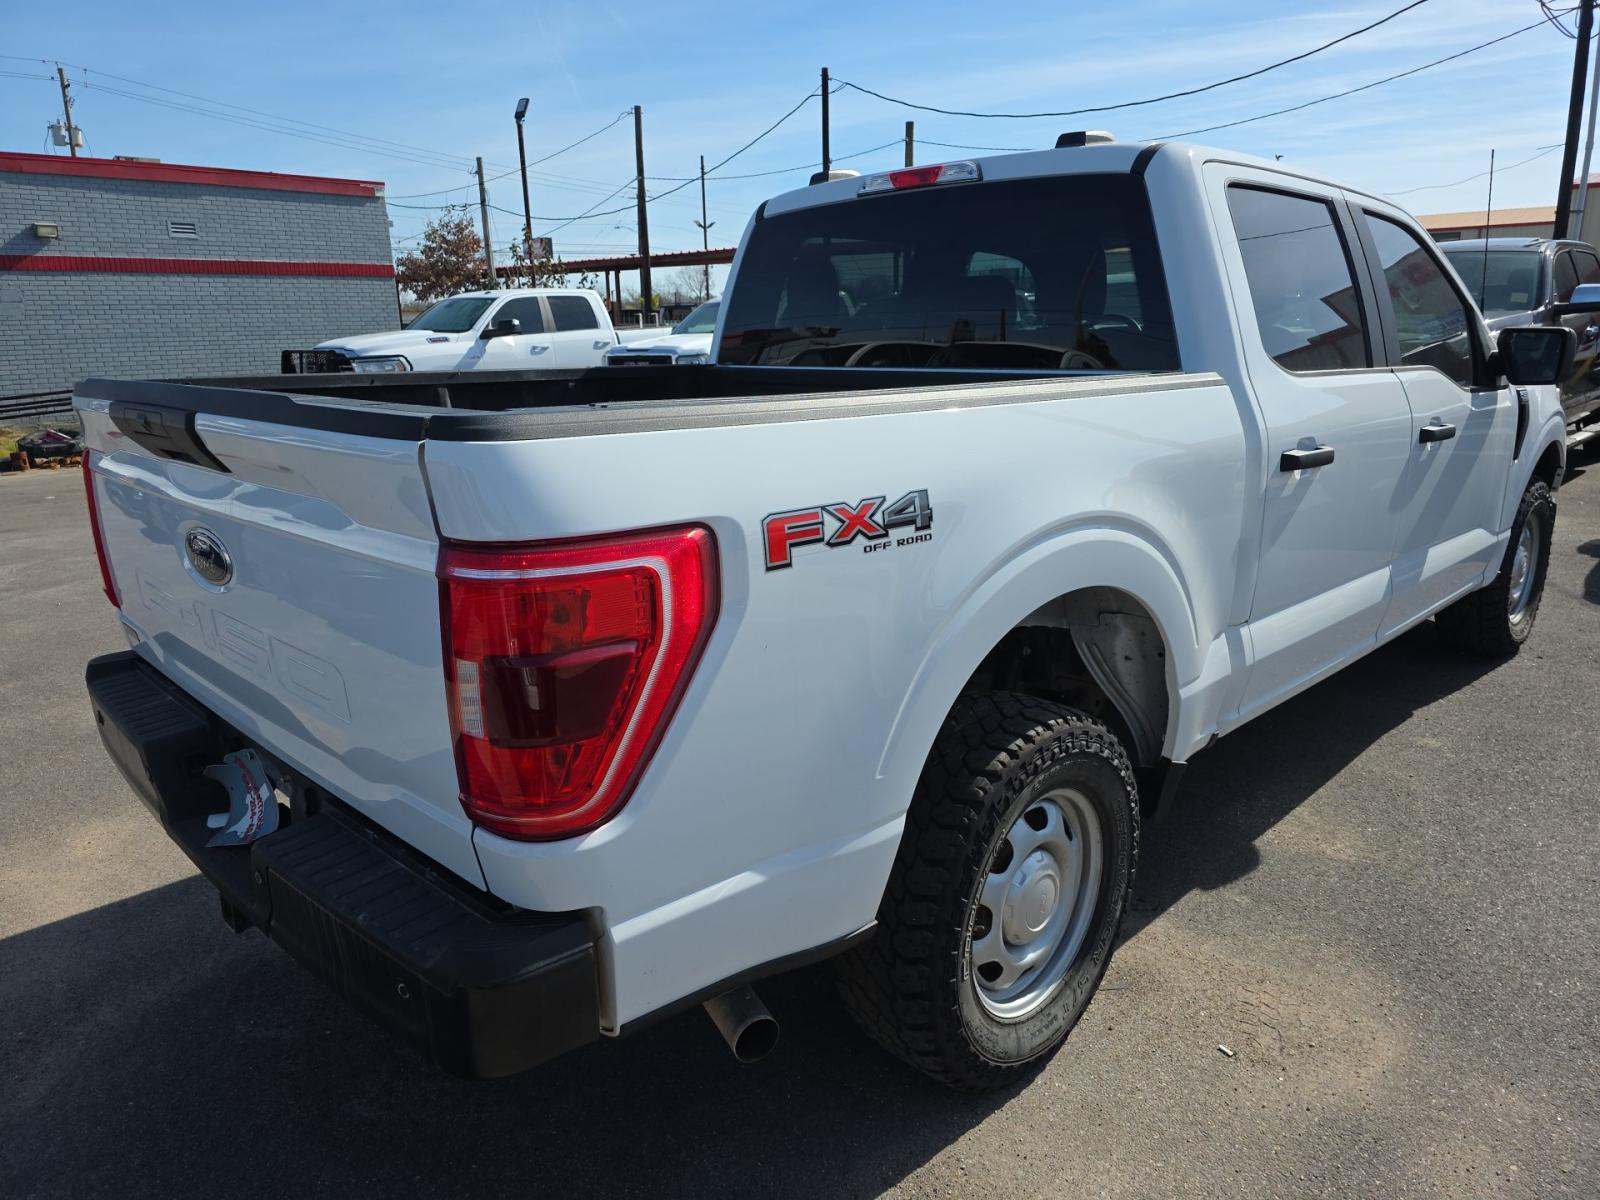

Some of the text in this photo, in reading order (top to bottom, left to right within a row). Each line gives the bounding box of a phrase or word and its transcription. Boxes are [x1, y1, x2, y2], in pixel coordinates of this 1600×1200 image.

[761, 488, 933, 572] FX4
[864, 533, 932, 553] OFF ROAD
